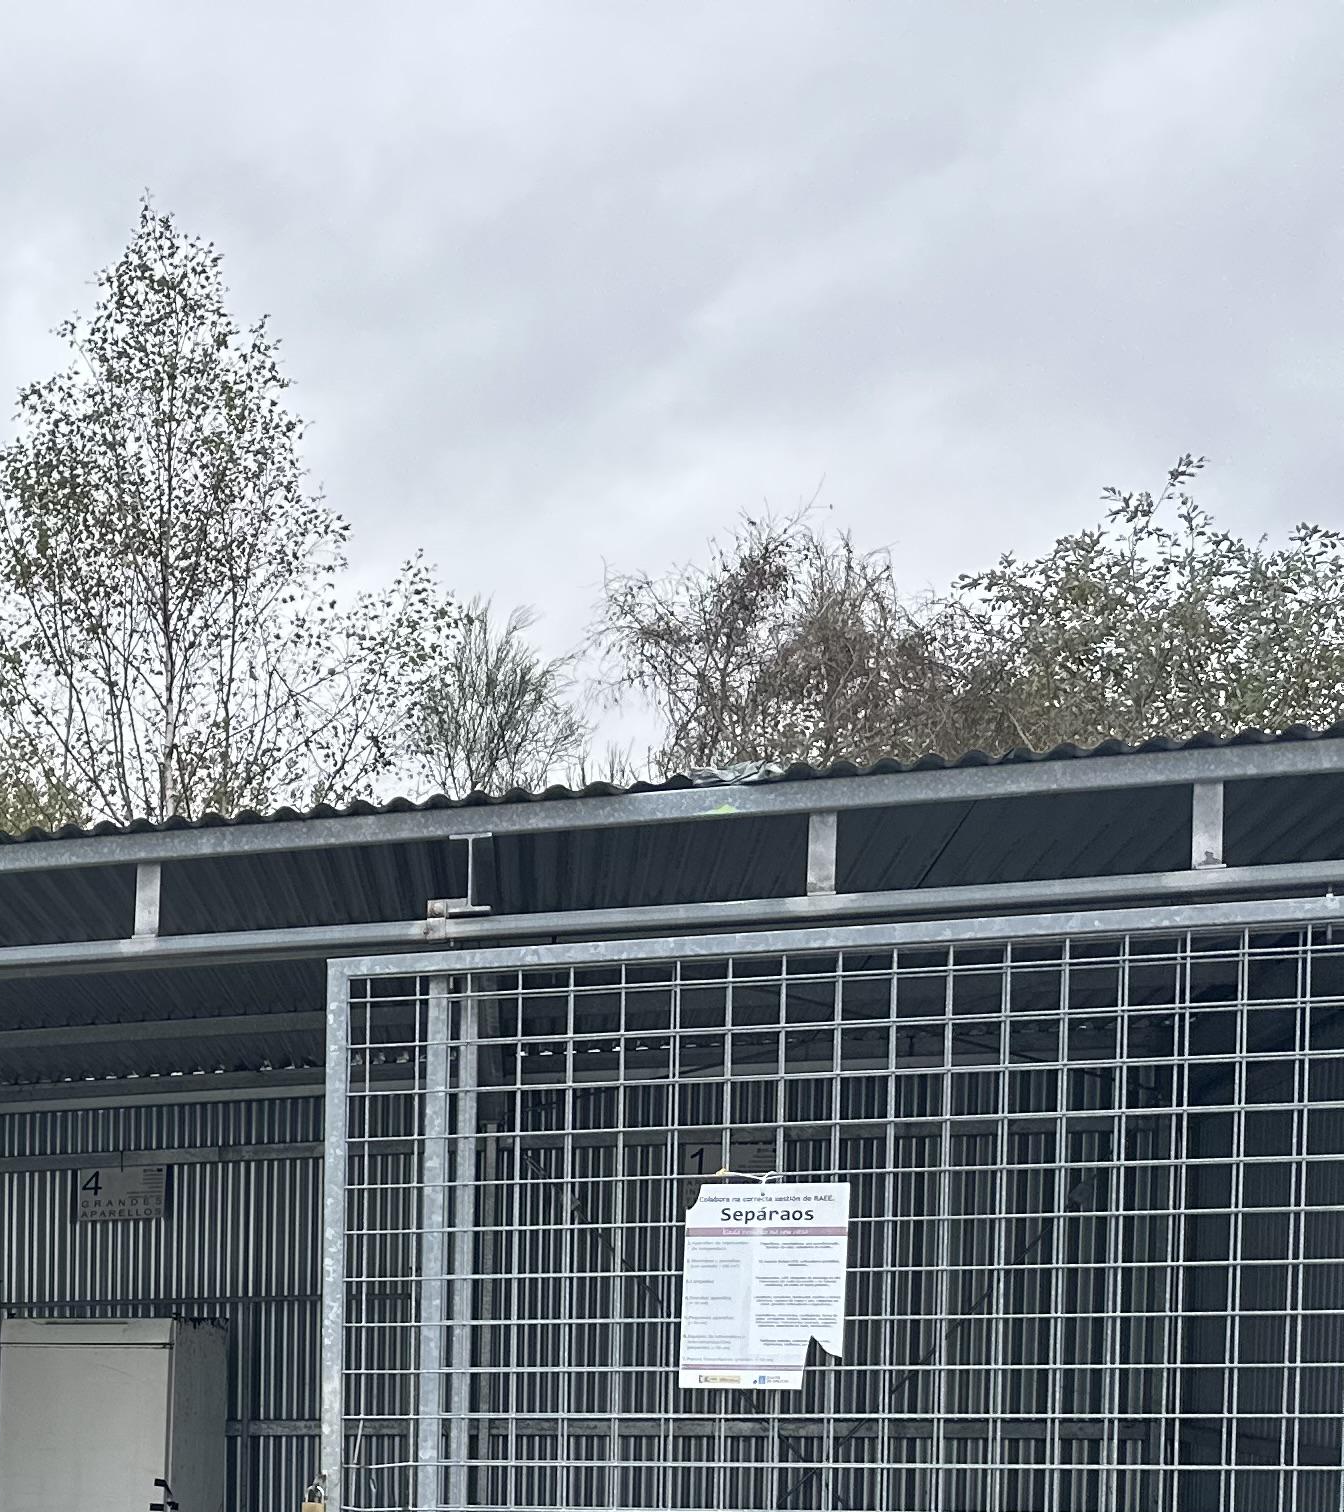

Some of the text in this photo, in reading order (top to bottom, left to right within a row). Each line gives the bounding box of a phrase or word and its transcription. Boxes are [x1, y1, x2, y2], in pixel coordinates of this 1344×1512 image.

[691, 1147, 704, 1176] 1
[81, 1170, 102, 1196] 4
[81, 1197, 162, 1208] GRANDES
[80, 1208, 161, 1218] APARELLOS
[720, 1207, 814, 1224] Sepáraos
